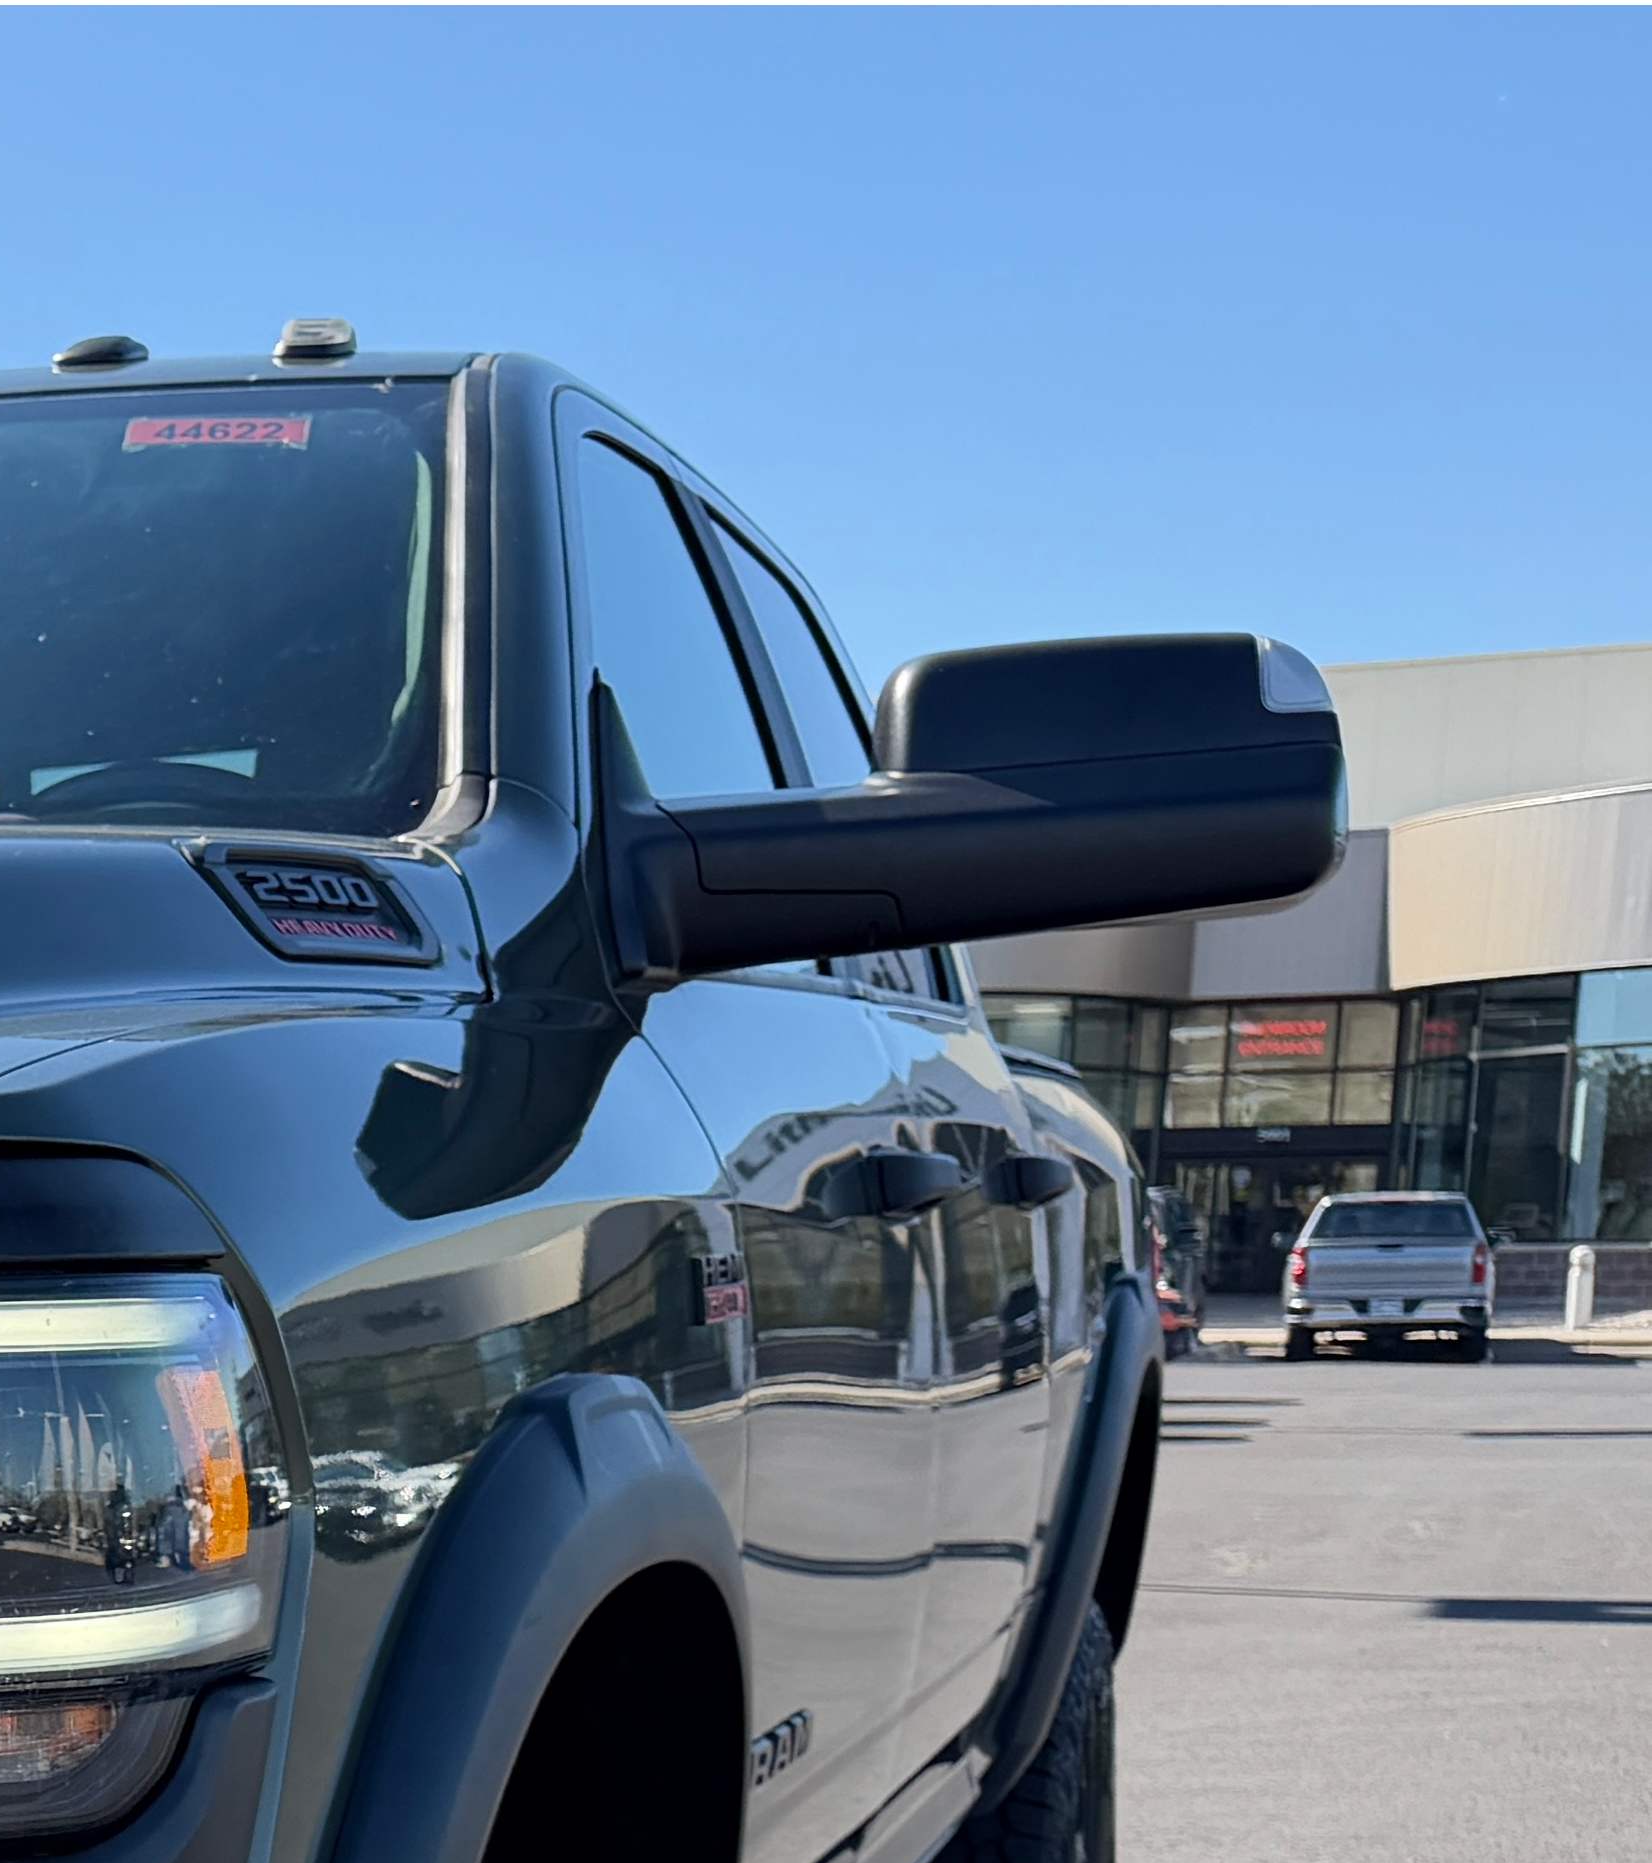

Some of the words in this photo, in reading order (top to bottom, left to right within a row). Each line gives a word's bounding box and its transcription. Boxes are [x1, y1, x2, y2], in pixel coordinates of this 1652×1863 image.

[152, 421, 286, 441] 44622
[242, 868, 380, 910] 2500
[271, 918, 343, 937] HEAVY
